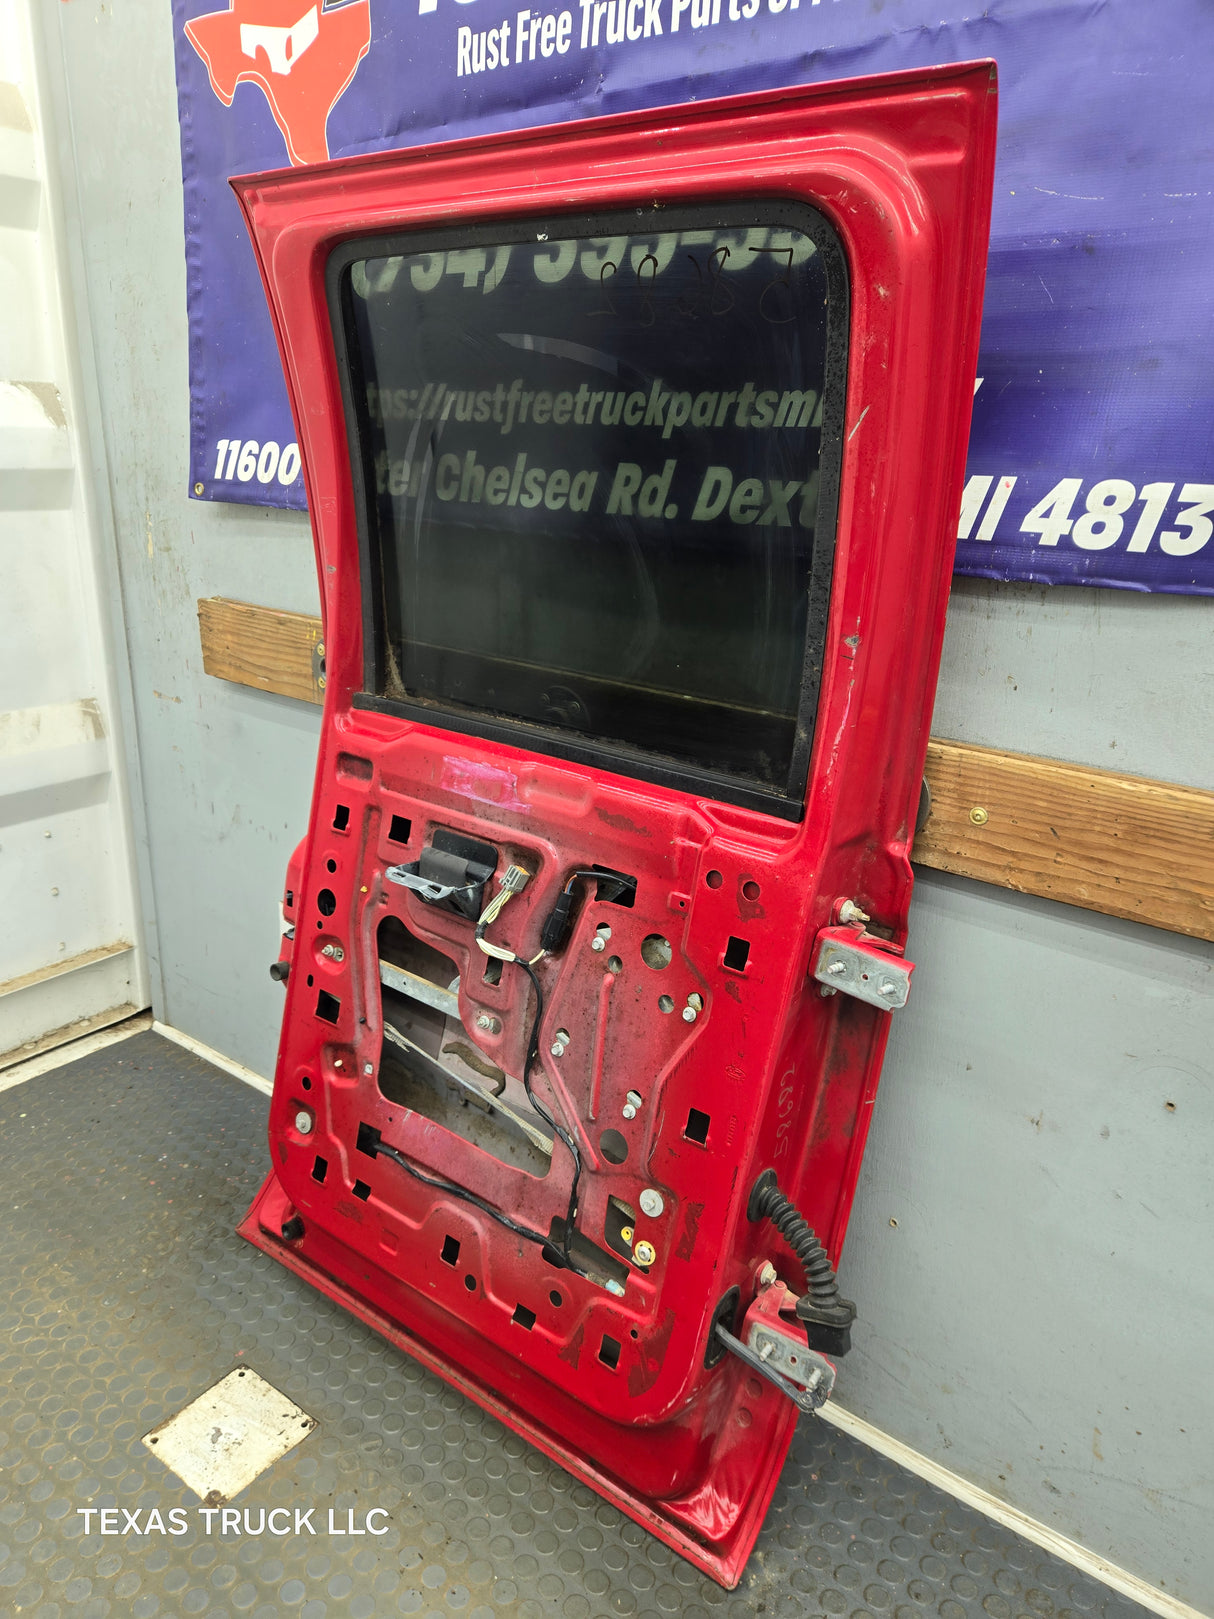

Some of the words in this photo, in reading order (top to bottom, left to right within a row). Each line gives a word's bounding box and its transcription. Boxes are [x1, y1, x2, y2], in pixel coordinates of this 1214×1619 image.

[456, 20, 511, 77] Rust
[515, 9, 573, 63] Free
[580, 0, 663, 49] Truck
[214, 439, 302, 486] 11600
[435, 450, 599, 512] Chelsea
[606, 459, 678, 519] Rd.
[1019, 478, 1214, 556] 4813
